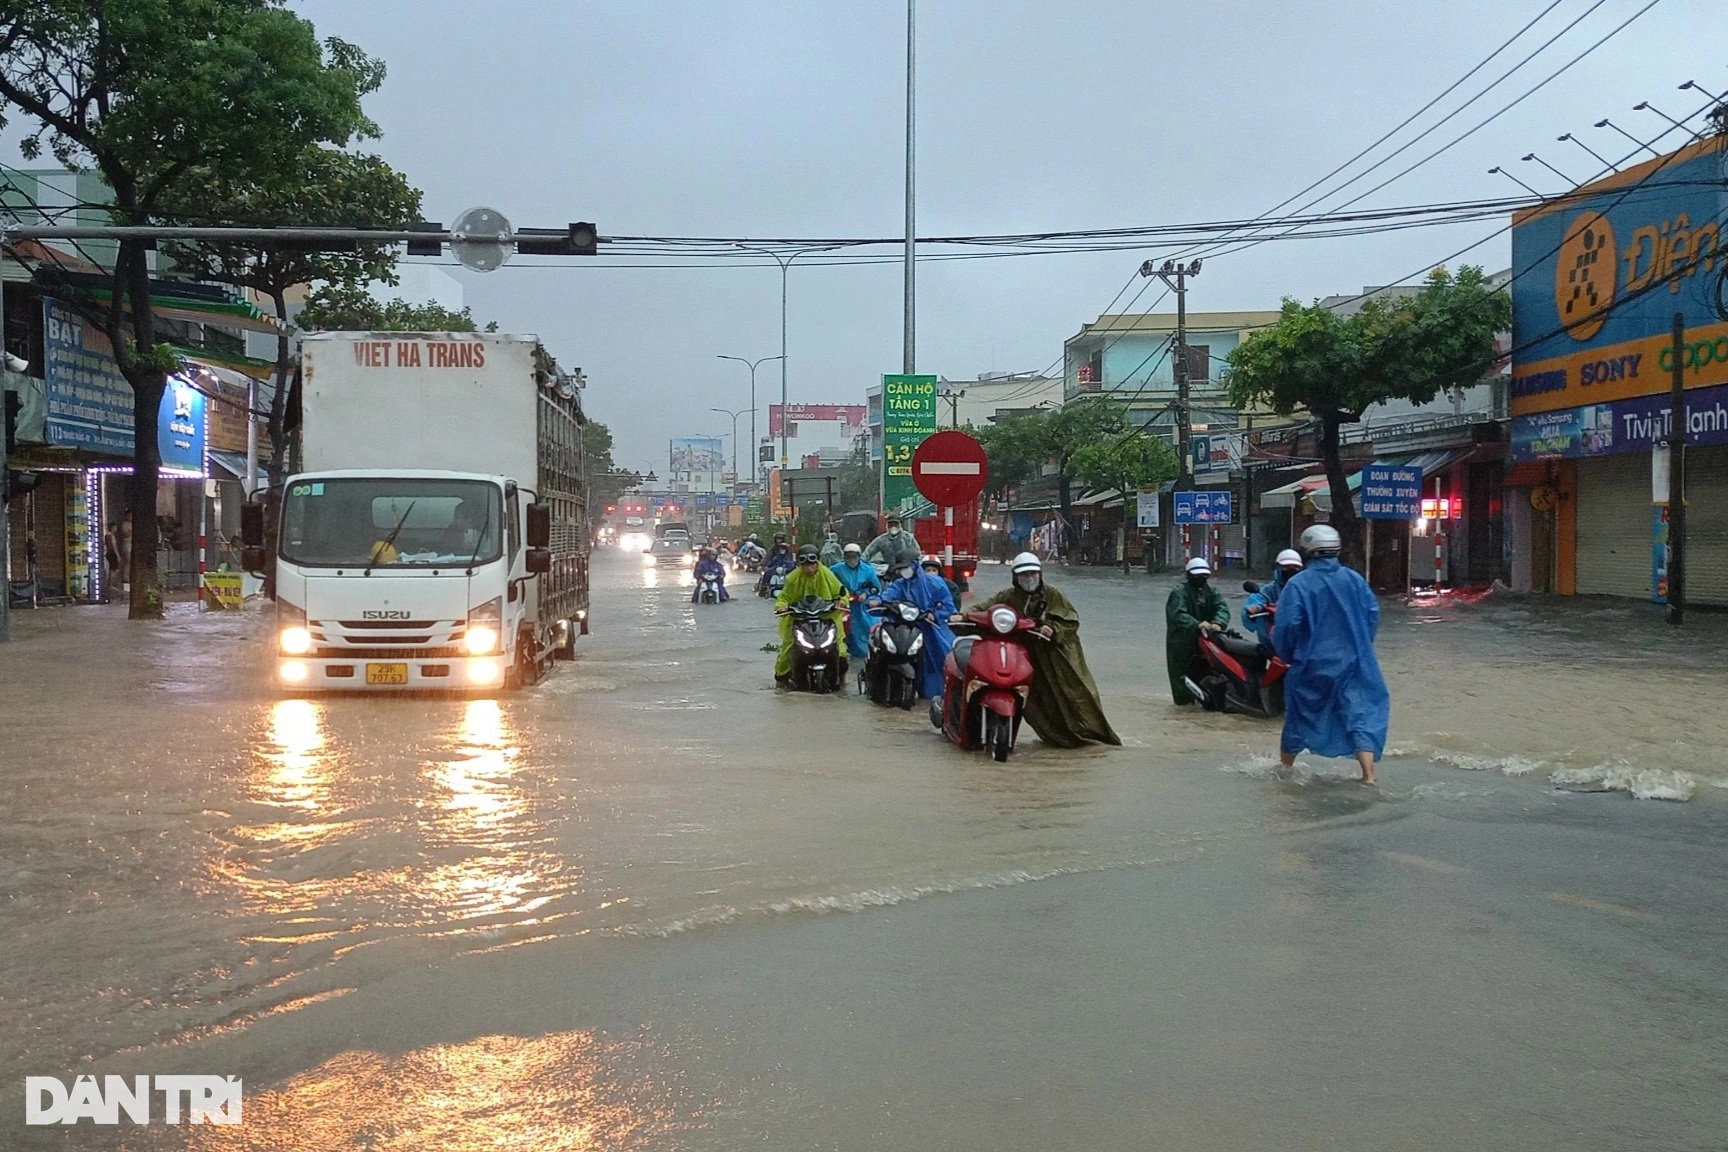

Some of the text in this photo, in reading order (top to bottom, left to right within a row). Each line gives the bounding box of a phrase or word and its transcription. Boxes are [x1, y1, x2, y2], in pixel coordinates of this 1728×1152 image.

[1624, 212, 1719, 294] Điện
[354, 342, 485, 368] VIET HA TRANS
[1580, 353, 1643, 387] SONY
[887, 382, 934, 397] CĂN HỘ
[924, 399, 930, 410] 1
[1622, 402, 1728, 440] Tivi T lạnh
[886, 444, 911, 463] 1,3
[363, 610, 411, 620] ISUZU
